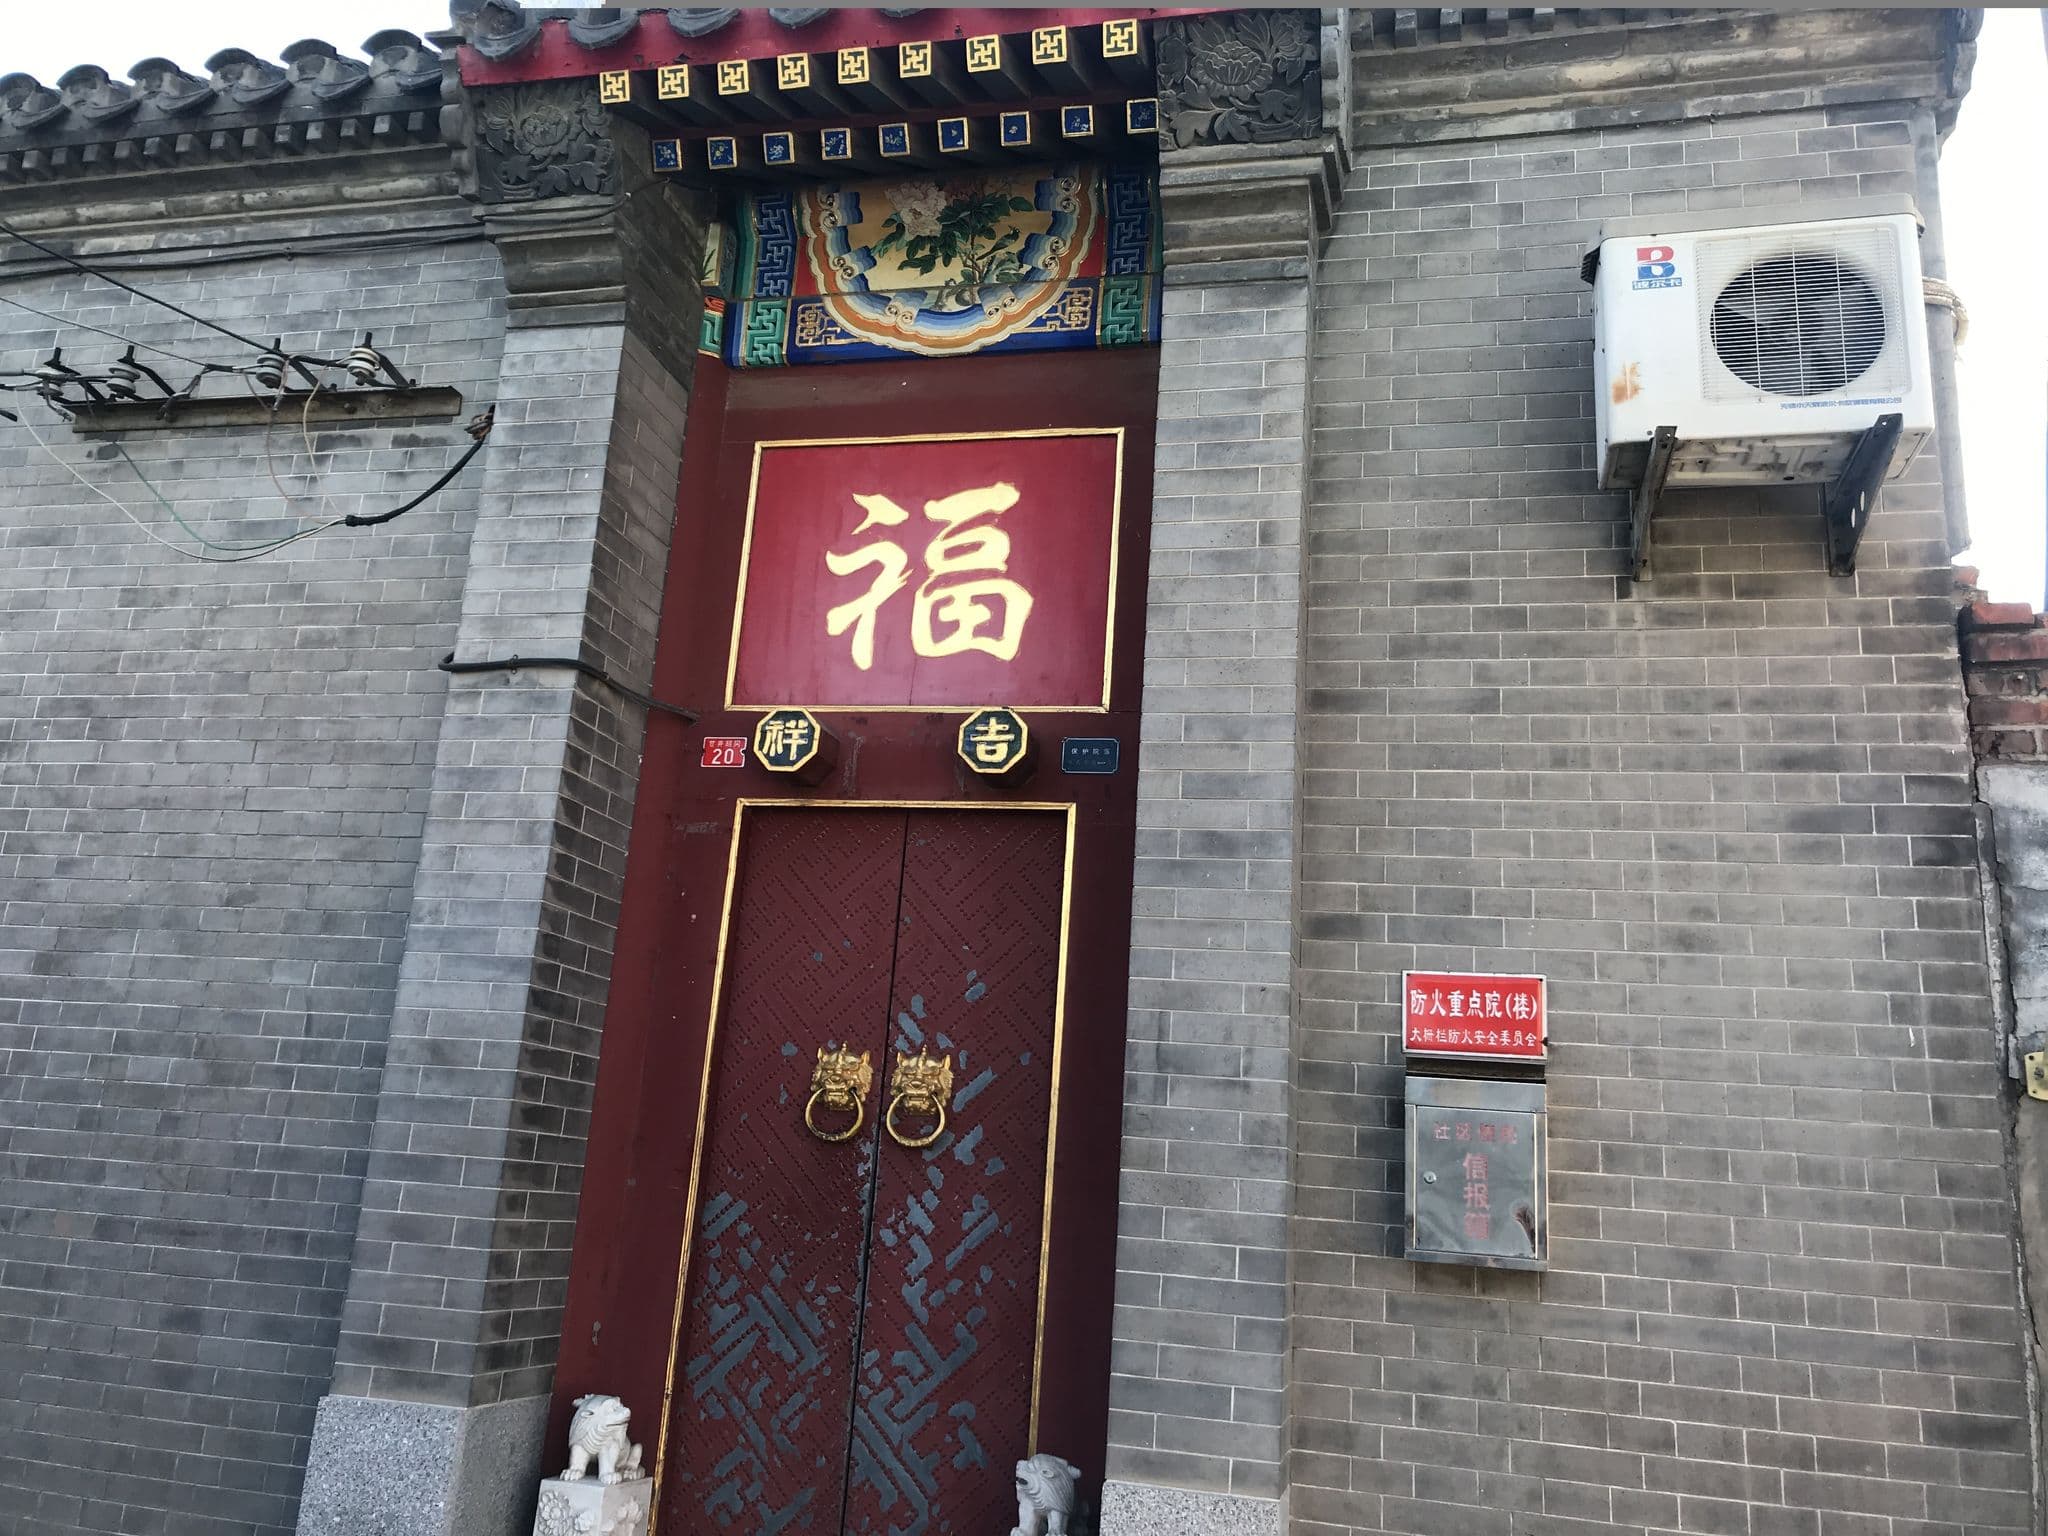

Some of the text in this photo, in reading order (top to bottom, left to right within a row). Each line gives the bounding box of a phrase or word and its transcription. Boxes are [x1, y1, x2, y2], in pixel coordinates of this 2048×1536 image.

[825, 481, 1034, 672] 福
[711, 748, 734, 765] 20
[761, 719, 809, 761] 祥
[969, 718, 1015, 762] 吉
[1409, 987, 1538, 1020] 防火重点院(楼)
[1409, 1027, 1537, 1047] 大栅栏防火安全委员会
[1463, 1152, 1490, 1240] 信报箱
